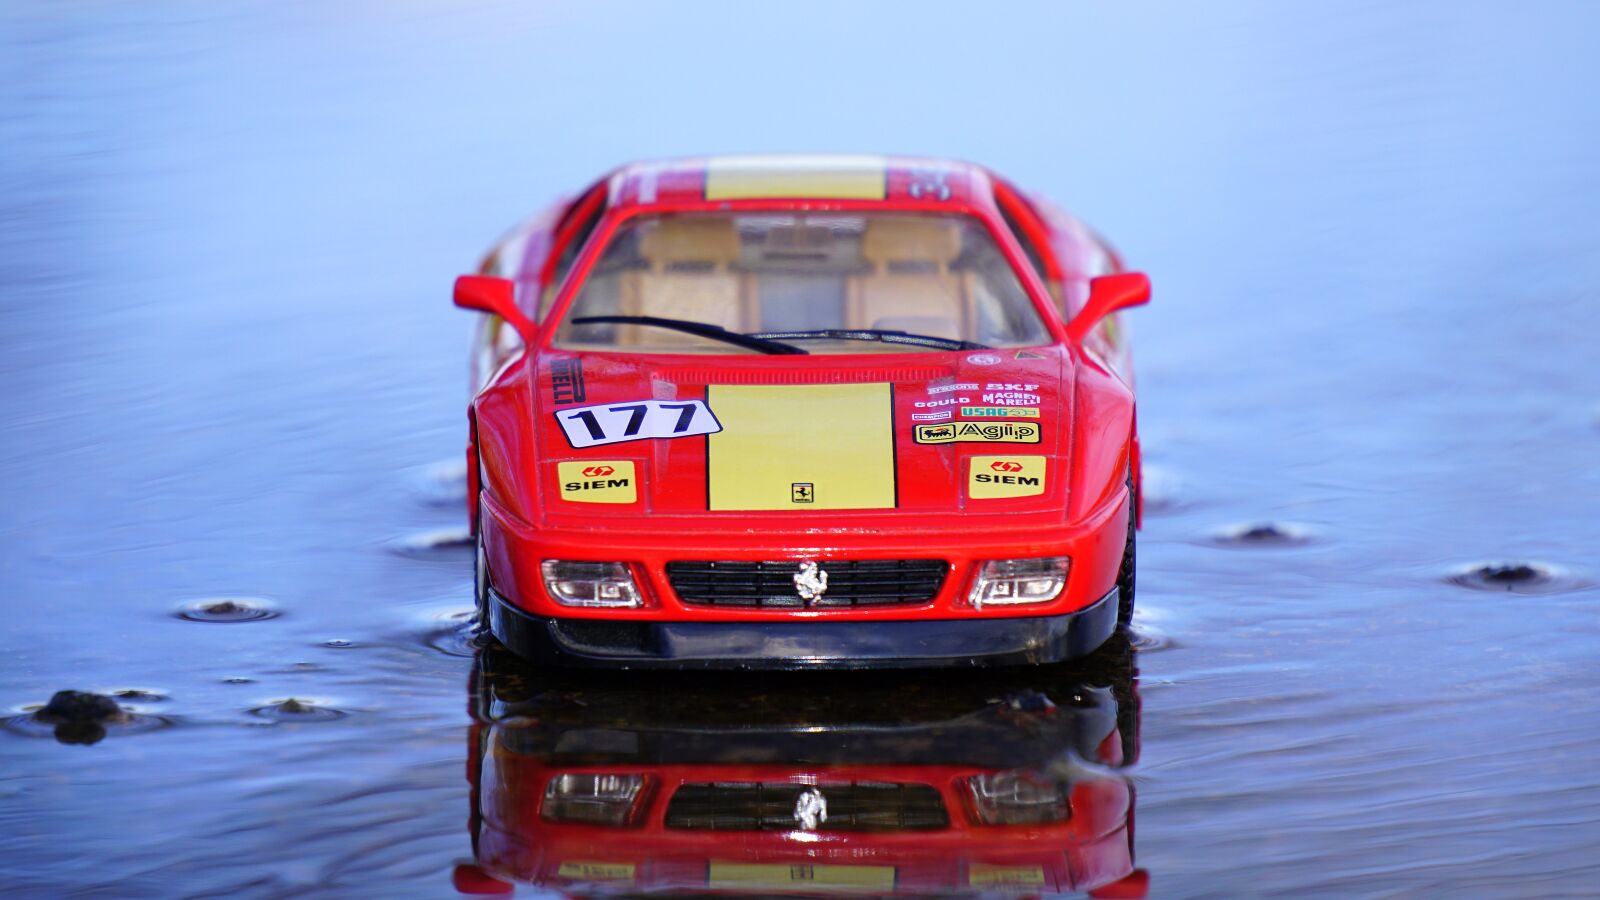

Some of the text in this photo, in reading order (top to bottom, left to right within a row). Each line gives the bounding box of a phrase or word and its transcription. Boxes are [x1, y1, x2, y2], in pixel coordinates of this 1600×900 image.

[985, 383, 1040, 391] SKF
[914, 397, 971, 408] GOULD
[962, 407, 1008, 416] USAG
[567, 403, 698, 440] 177
[958, 423, 1035, 440] Agip
[565, 478, 629, 491] SIEM
[975, 474, 1040, 486] SIEM
